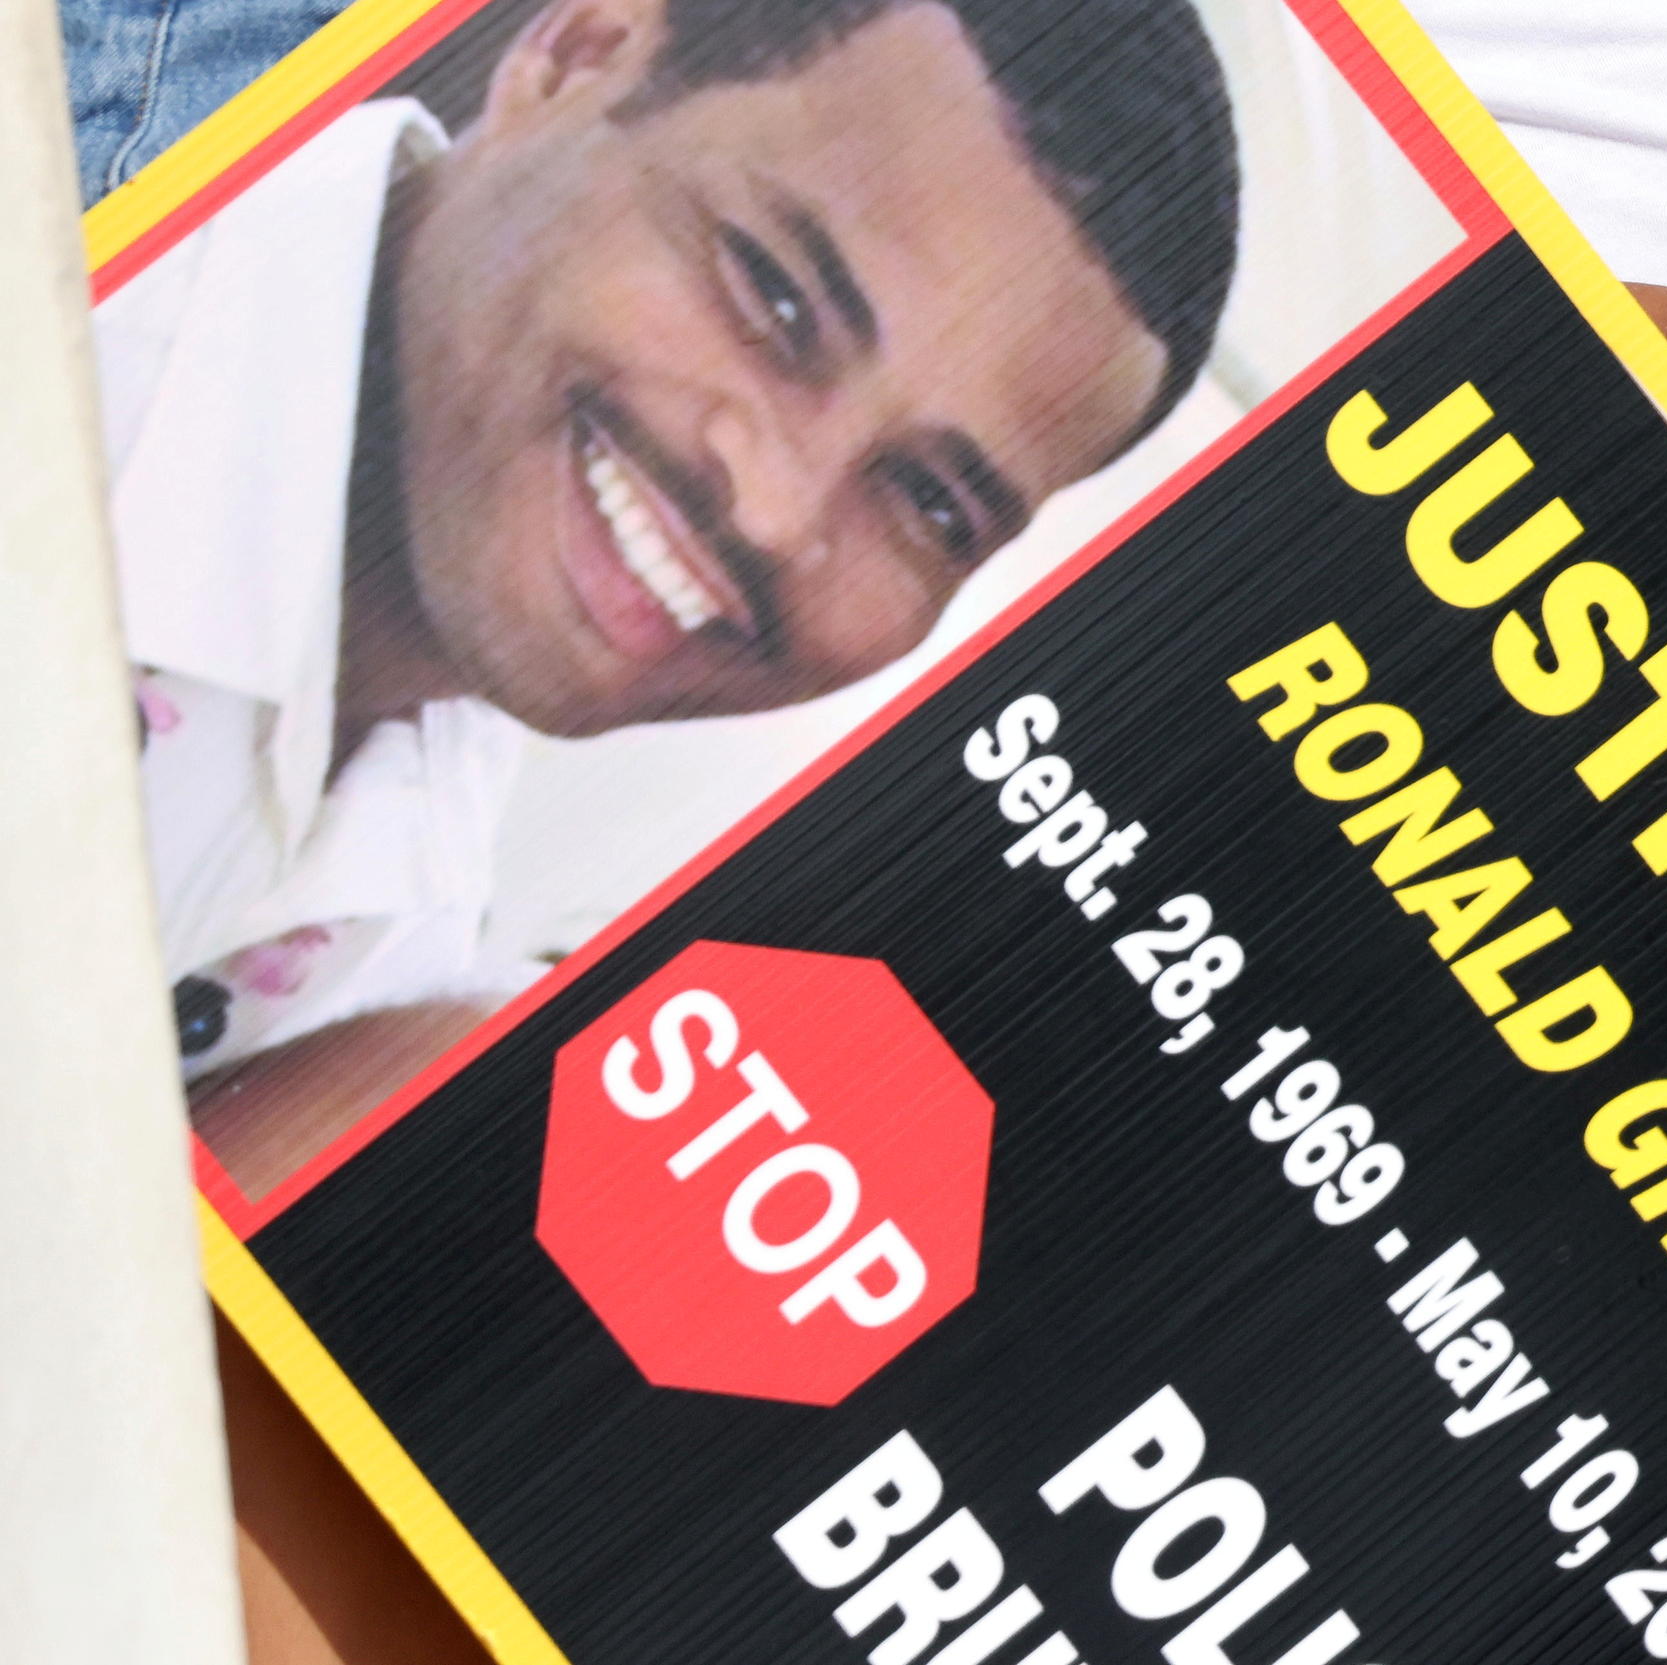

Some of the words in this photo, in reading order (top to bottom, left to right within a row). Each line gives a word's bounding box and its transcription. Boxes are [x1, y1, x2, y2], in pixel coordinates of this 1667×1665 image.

[1226, 620, 1635, 1074] RONALD
[601, 987, 928, 1329] STOP
[963, 692, 1149, 922] Sept.
[1111, 892, 1246, 1056] 28,
[1220, 1024, 1406, 1226] 1969
[1387, 1237, 1549, 1438] May
[1520, 1412, 1640, 1570] 10,
